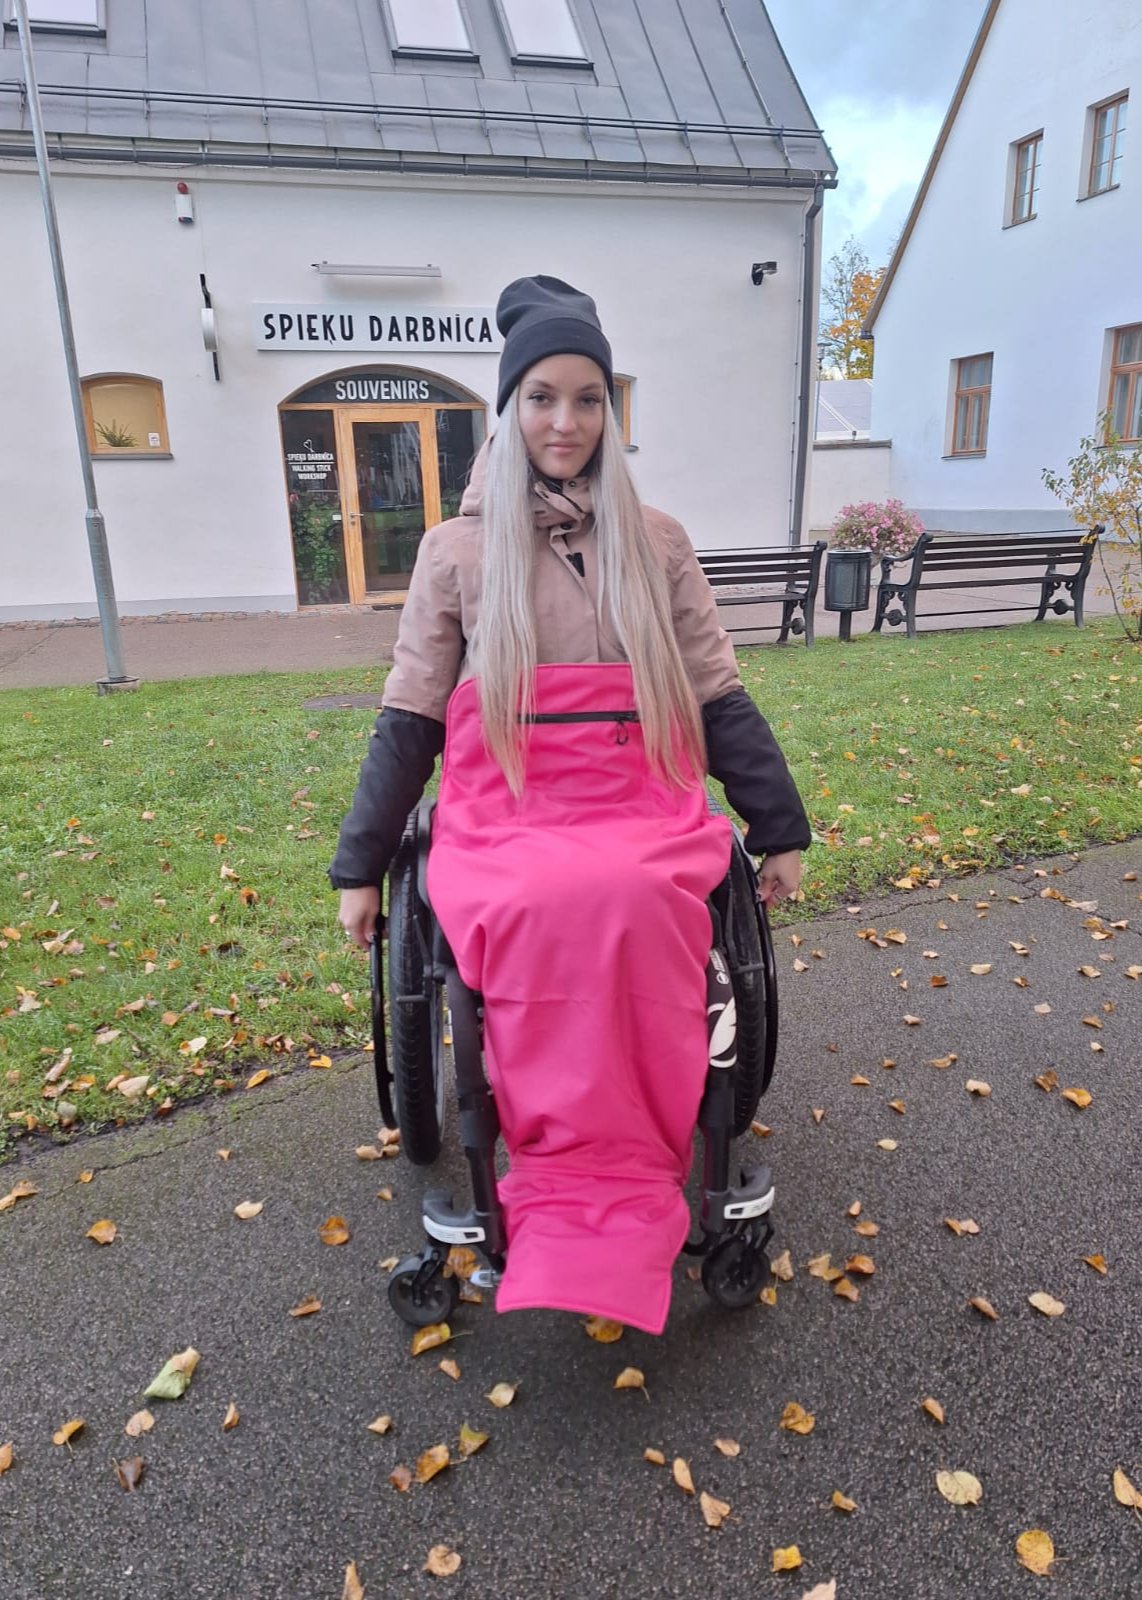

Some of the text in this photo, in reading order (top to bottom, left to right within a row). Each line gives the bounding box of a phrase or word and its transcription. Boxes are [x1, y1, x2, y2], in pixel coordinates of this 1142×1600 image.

[263, 313, 493, 344] SPIEĶU DARBNĪCA
[335, 380, 429, 400] SOUVENIRS
